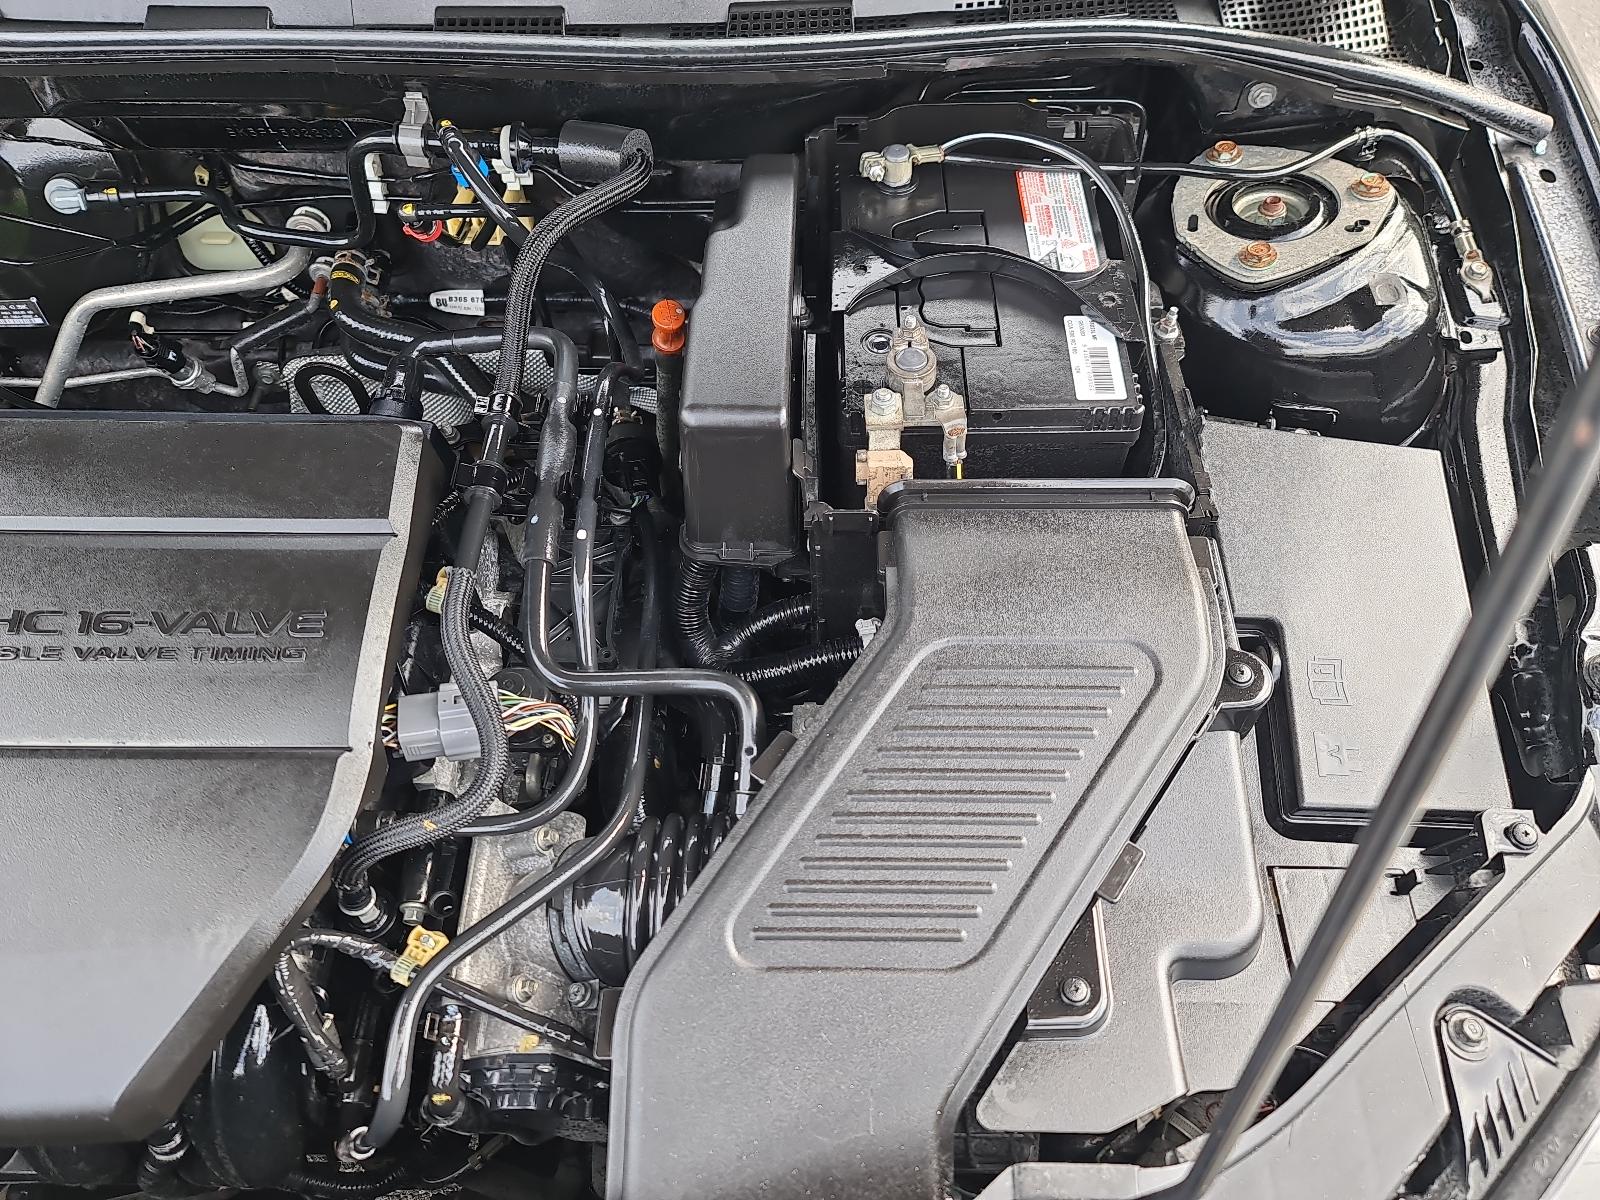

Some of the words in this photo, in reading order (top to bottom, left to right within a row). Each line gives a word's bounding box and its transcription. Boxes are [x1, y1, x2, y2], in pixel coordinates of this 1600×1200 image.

[77, 609, 328, 638] 16-VALVE
[72, 645, 178, 662] VALVE
[191, 646, 307, 663] TIMING
